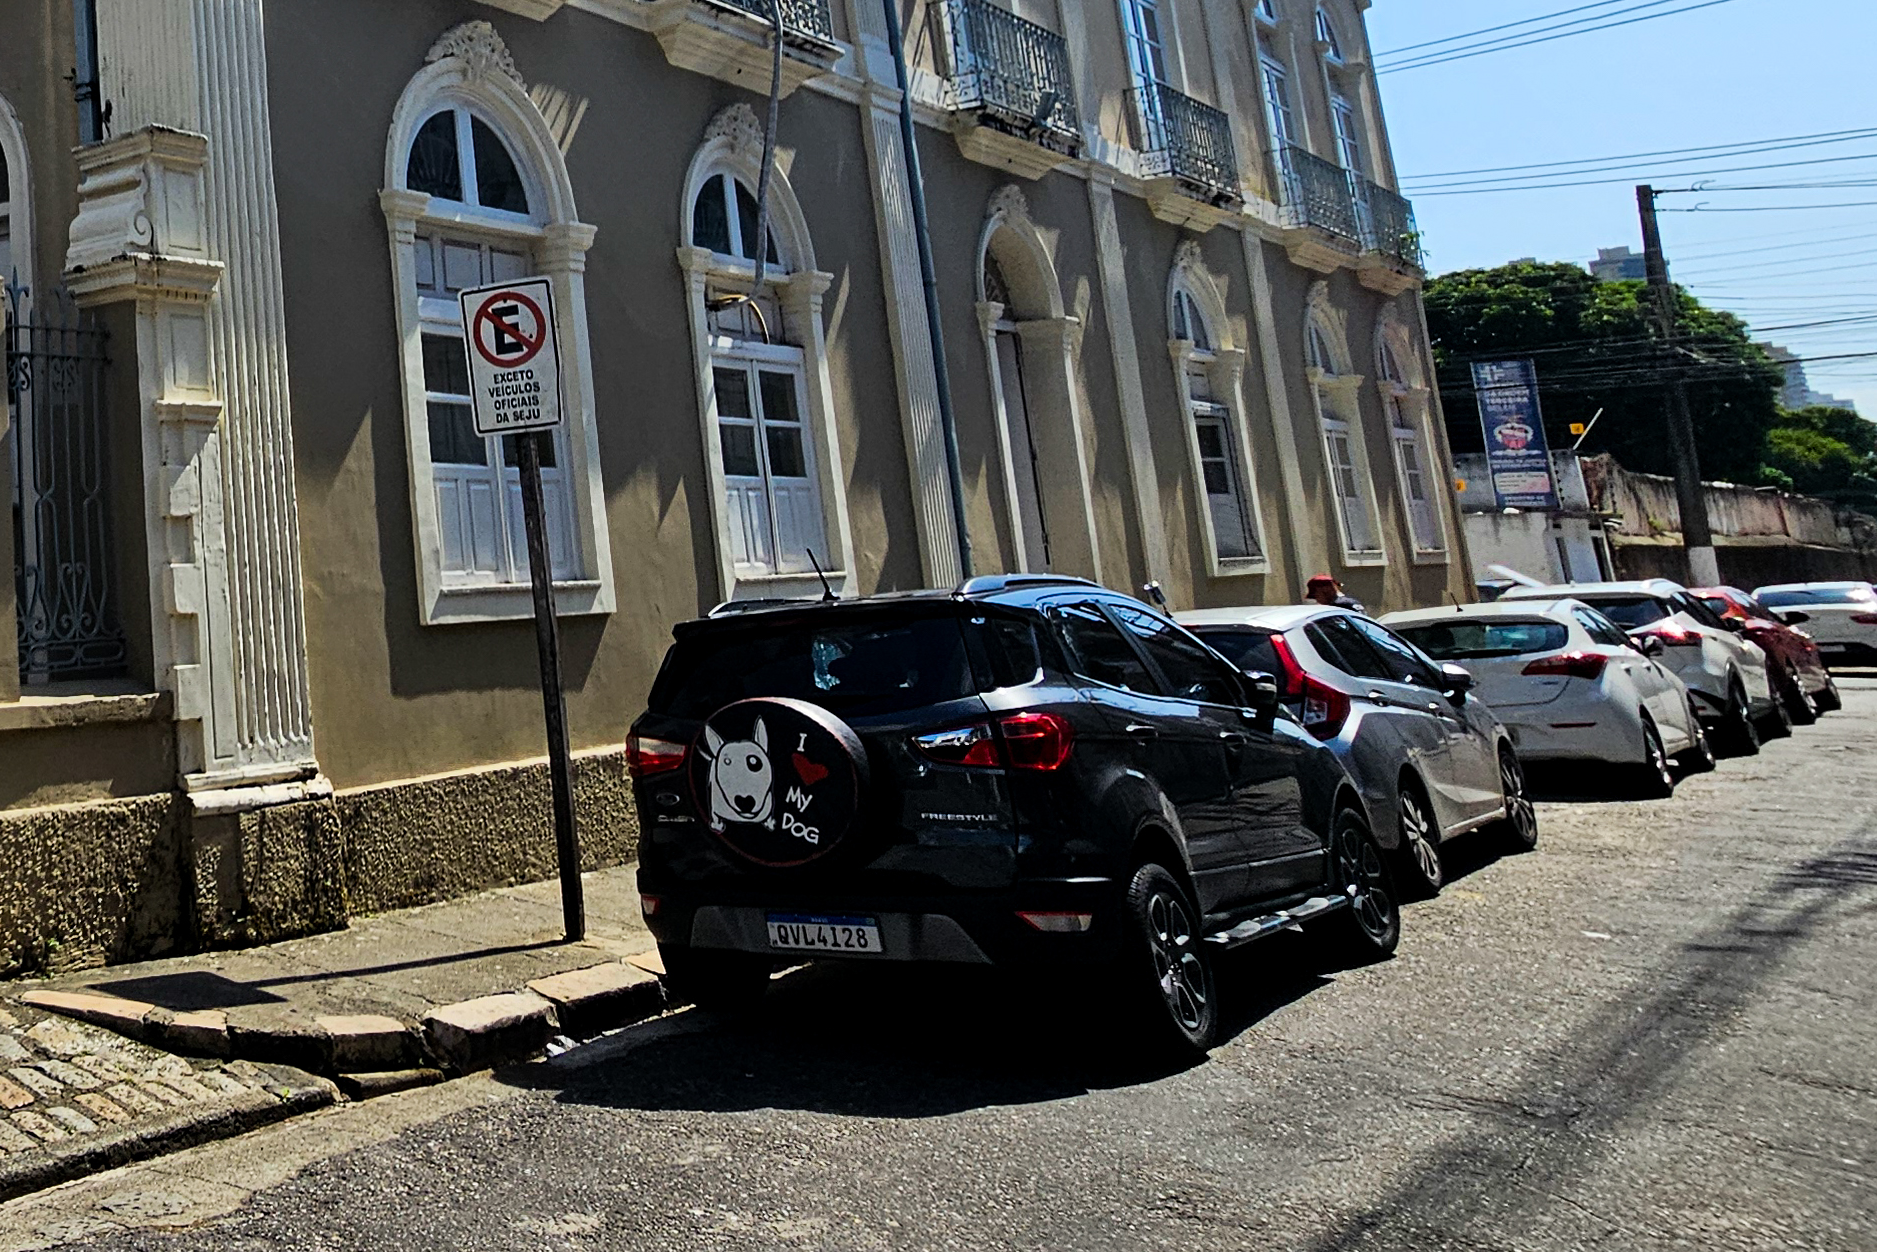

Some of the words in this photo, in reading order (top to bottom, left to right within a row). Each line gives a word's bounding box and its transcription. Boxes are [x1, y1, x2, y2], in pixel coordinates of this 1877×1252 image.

[493, 369, 533, 384] EXCETO
[494, 395, 539, 410] OFICIAIS
[496, 412, 510, 423] DA
[513, 408, 540, 421] SEJU
[796, 732, 808, 752] I
[920, 812, 998, 822] FREESTYLE
[782, 812, 820, 845] DOG
